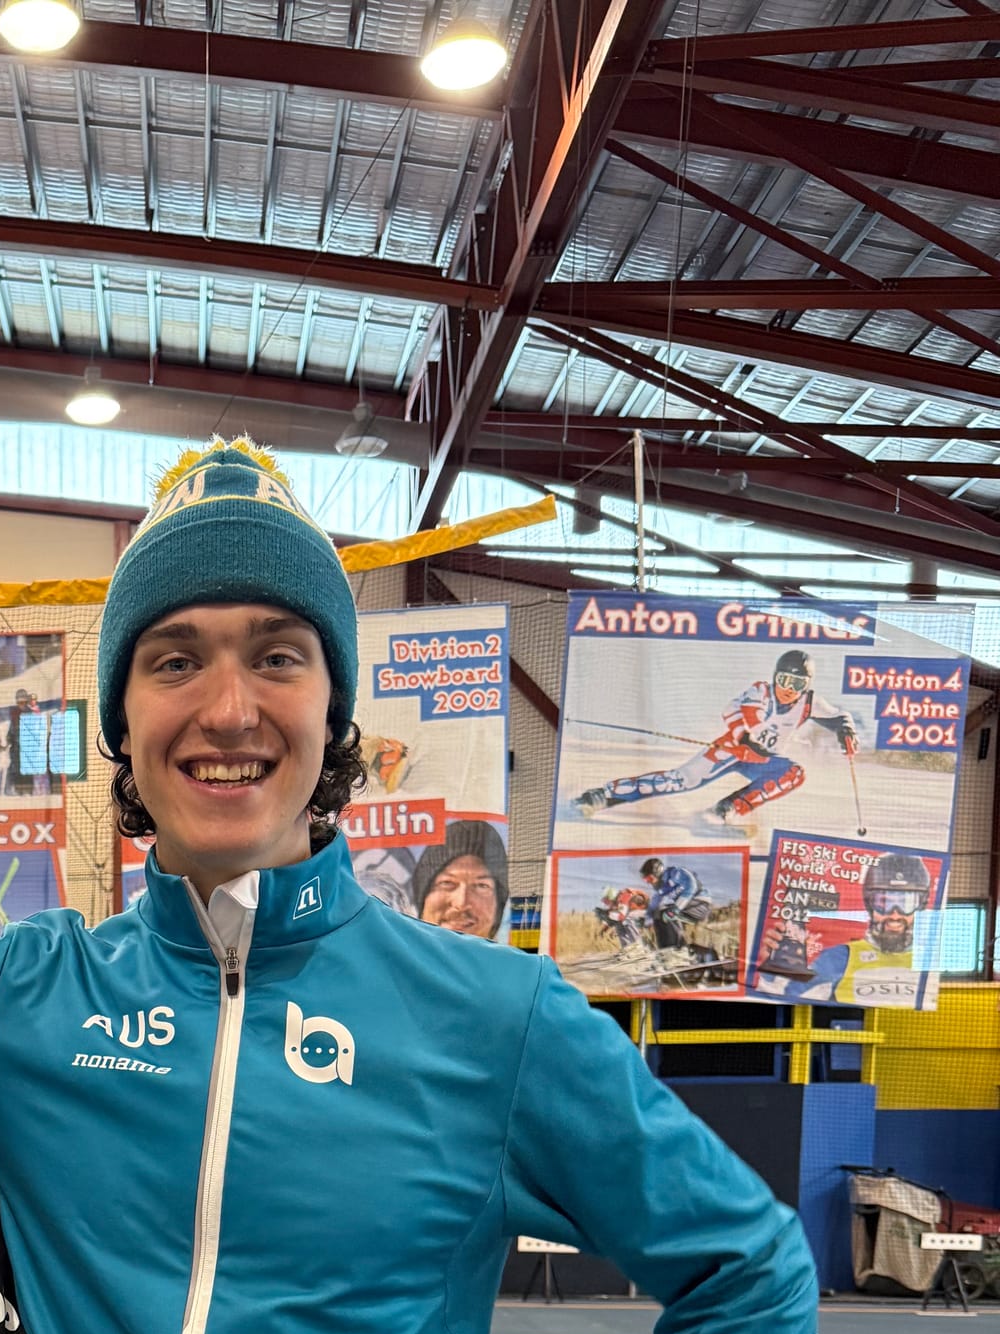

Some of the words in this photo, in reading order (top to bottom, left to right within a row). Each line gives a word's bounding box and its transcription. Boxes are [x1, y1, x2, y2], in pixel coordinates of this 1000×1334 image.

[574, 597, 698, 636] Anton
[392, 637, 483, 664] Division
[484, 635, 501, 657] 2
[378, 663, 501, 692] Snowboard
[848, 666, 939, 692] Division
[940, 667, 963, 691] 4
[433, 688, 501, 715] 2002
[880, 697, 961, 722] Alpine
[888, 723, 958, 748] 2001
[782, 841, 808, 857] FIS
[813, 845, 837, 861] Ski
[842, 850, 881, 867] Cross
[776, 873, 837, 894] Nakiska
[780, 857, 825, 875] World
[831, 865, 860, 884] Cup
[773, 890, 809, 907] CAN
[771, 905, 811, 923] 2012
[81, 1005, 176, 1049] AUS
[71, 1052, 173, 1075] noname
